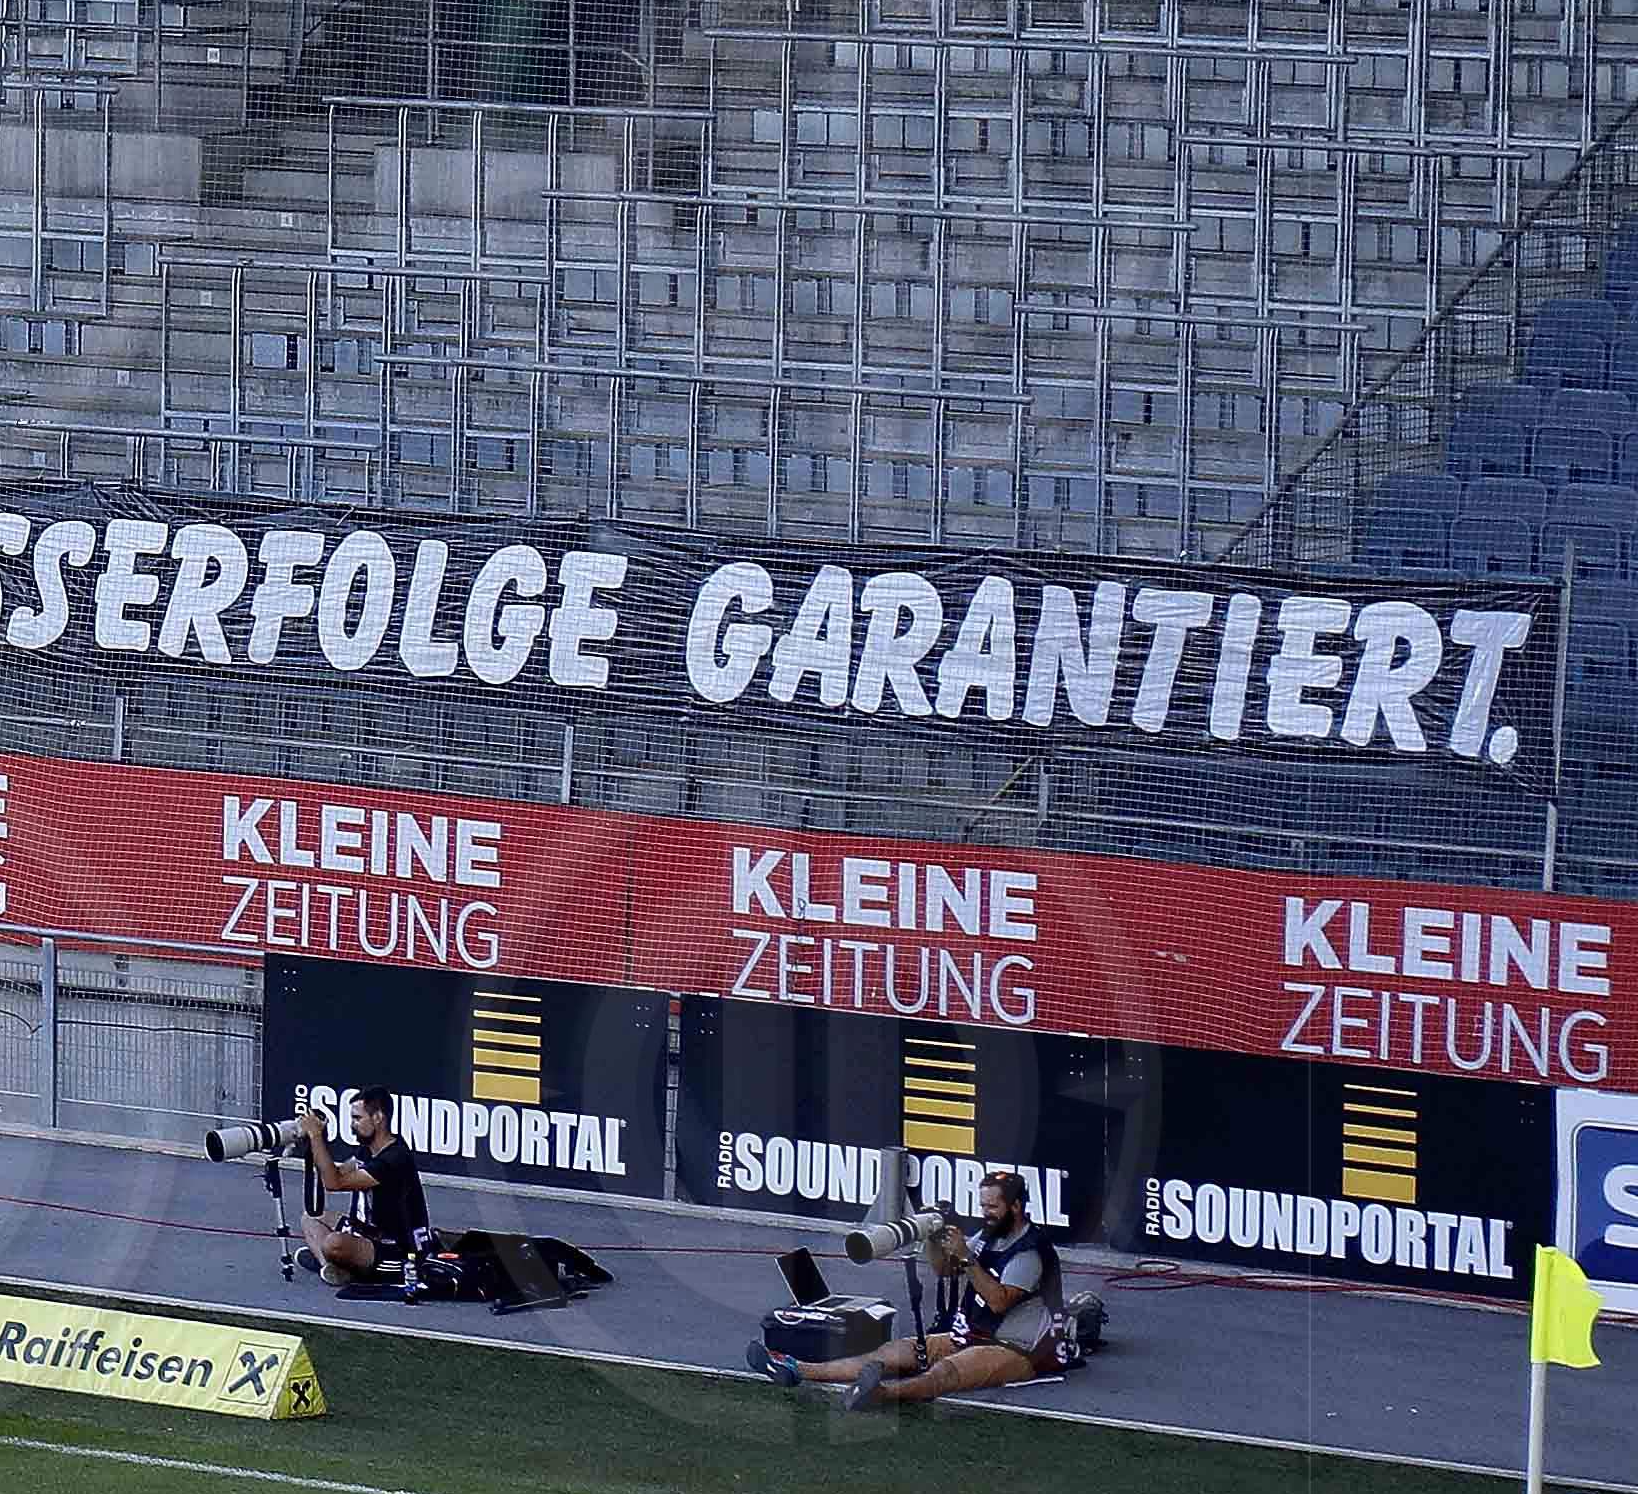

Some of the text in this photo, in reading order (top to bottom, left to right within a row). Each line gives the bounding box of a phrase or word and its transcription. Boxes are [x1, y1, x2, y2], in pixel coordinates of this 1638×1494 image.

[687, 560, 1531, 764] GARANTIERT.
[222, 795, 502, 888] KLEINE
[221, 876, 500, 968] ZEITUNG
[732, 847, 1037, 941] KLEINE
[731, 929, 1036, 1025] ZEITUNG
[1284, 897, 1611, 997] KLEINE
[1282, 981, 1609, 1083] ZEITUNG
[717, 1131, 733, 1188] RADIO
[1145, 1178, 1513, 1279] RADIO SOUNDPORTAL
